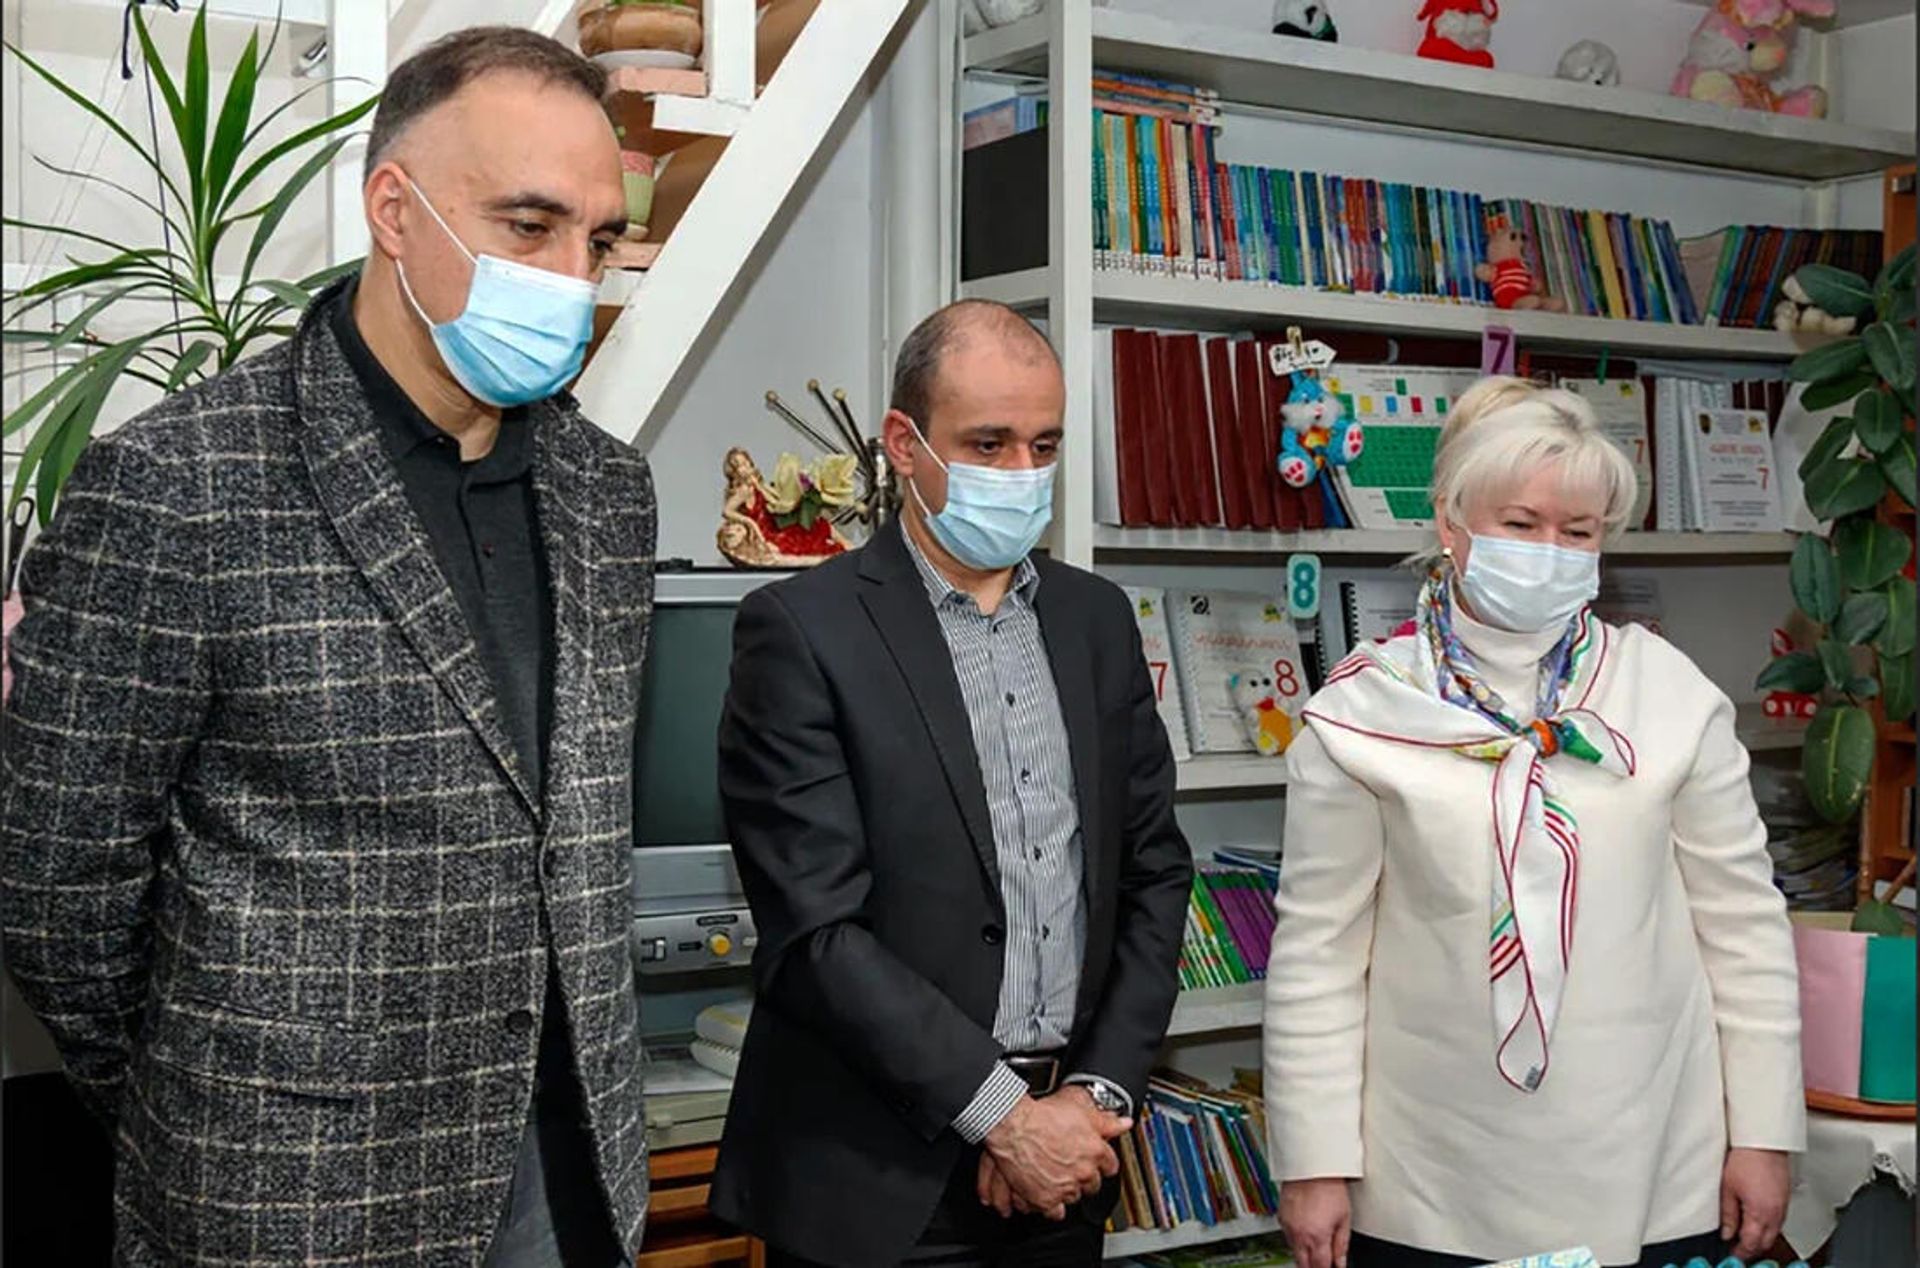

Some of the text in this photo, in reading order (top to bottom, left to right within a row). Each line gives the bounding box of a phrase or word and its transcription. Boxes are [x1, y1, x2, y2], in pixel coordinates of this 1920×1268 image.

[1488, 331, 1510, 375] 7
[1634, 439, 1646, 463] 7
[1757, 467, 1769, 490] 7
[1293, 562, 1317, 609] 8
[1149, 661, 1169, 702] 7
[1273, 658, 1300, 697] 8
